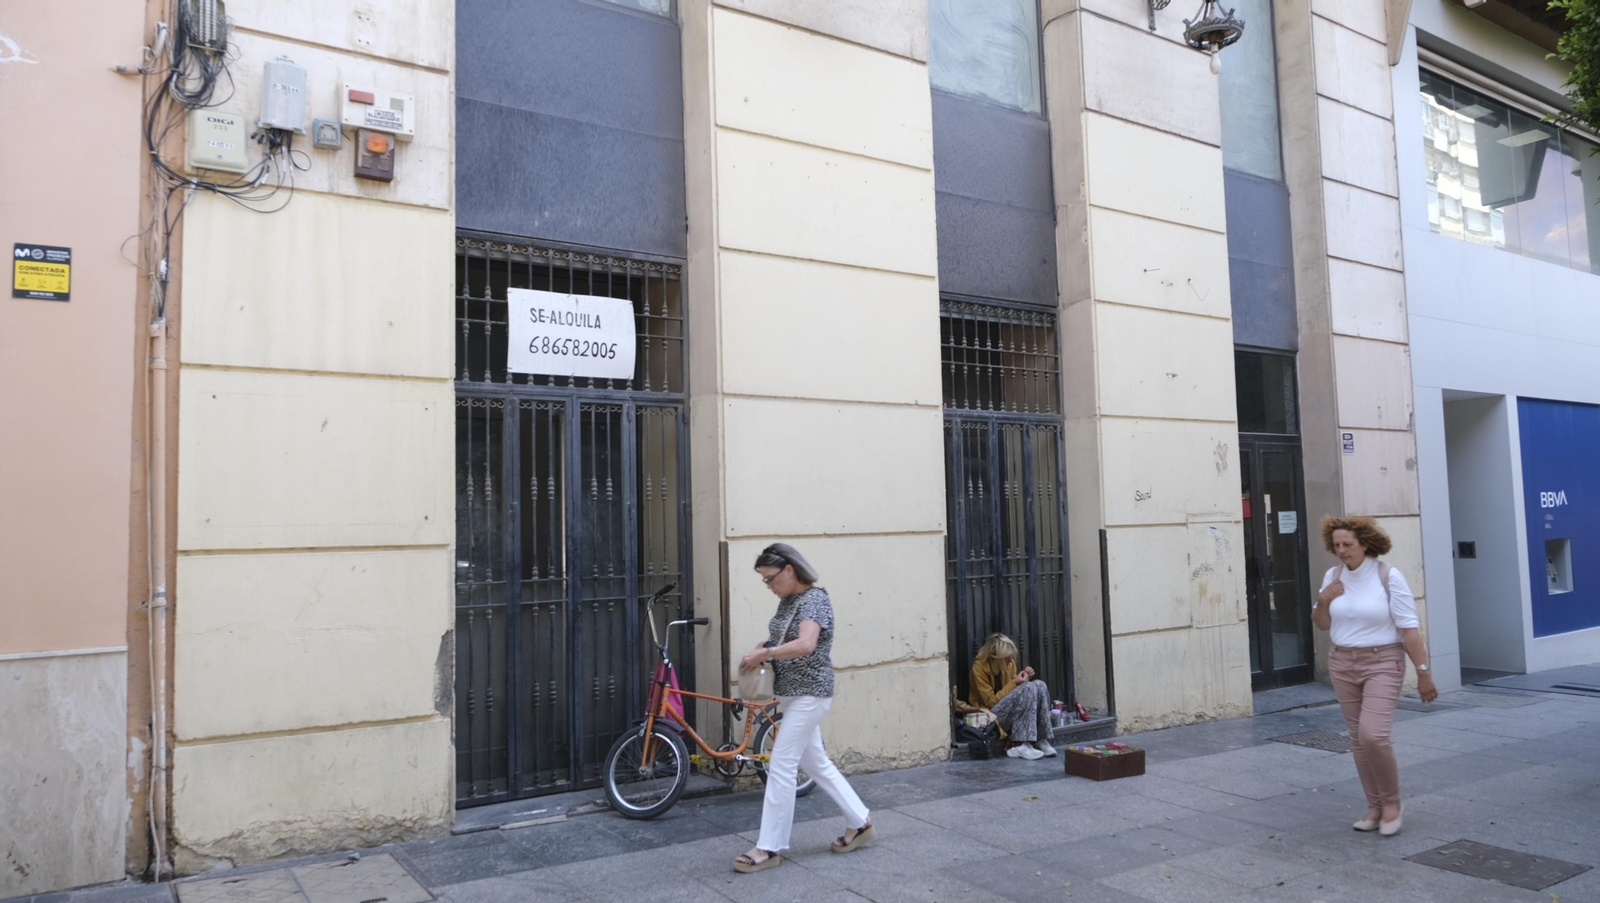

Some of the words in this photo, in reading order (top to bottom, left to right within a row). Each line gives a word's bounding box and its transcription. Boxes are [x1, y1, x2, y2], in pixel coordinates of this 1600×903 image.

[207, 116, 234, 125] DIGI
[18, 265, 66, 274] CONECTADA
[529, 307, 602, 329] SE-ALQUILA
[528, 335, 618, 360] 686582005
[1540, 489, 1568, 508] BBVA
